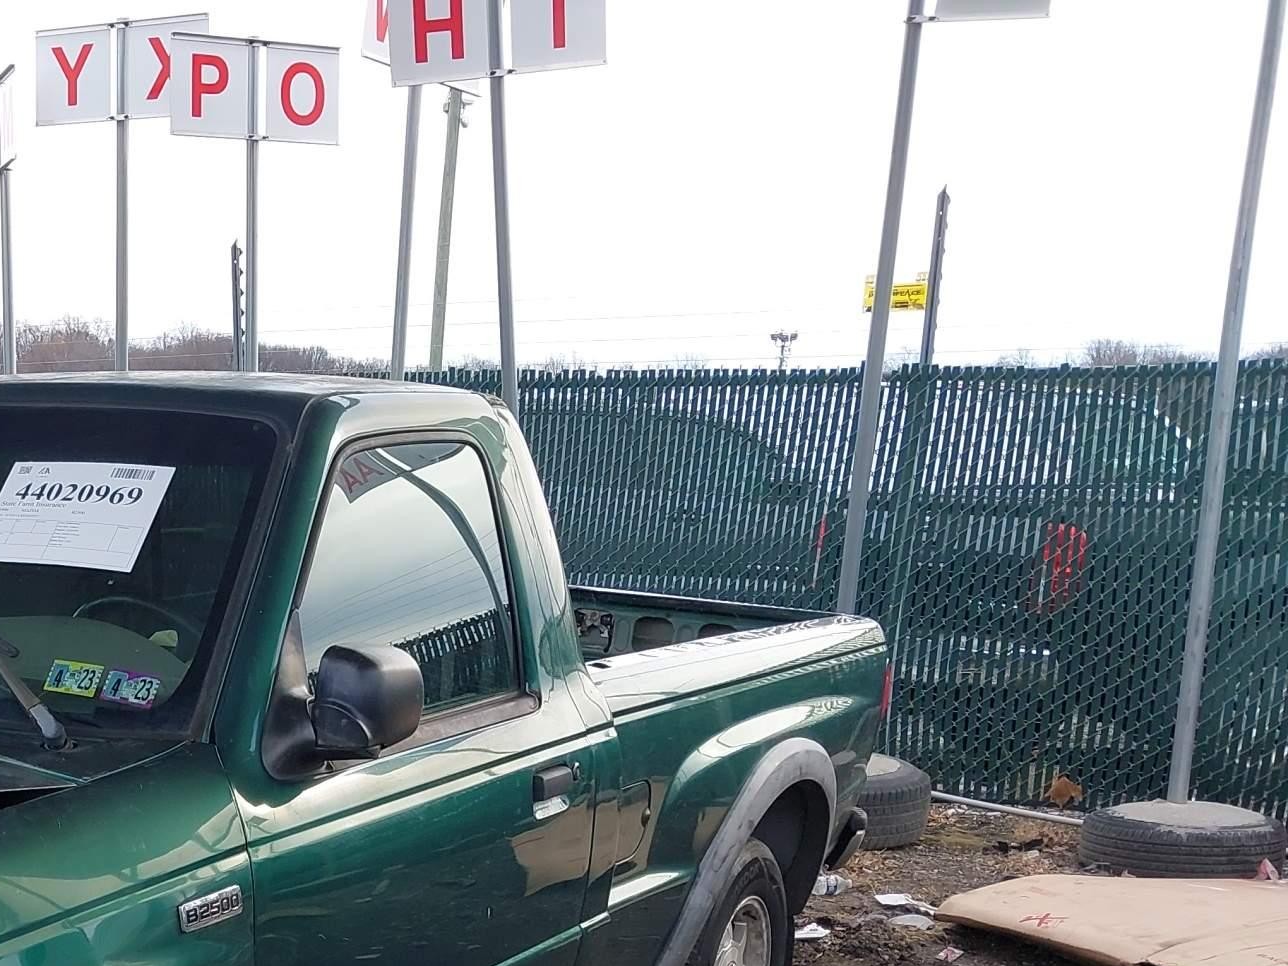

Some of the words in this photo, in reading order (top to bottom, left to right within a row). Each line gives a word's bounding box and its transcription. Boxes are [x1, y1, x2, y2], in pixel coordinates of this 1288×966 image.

[413, 0, 464, 63] H
[51, 43, 94, 106] Y
[191, 53, 229, 118] P
[280, 62, 325, 126] O
[15, 482, 144, 506] 44020969
[53, 669, 64, 688] 4
[77, 669, 96, 691] 23
[110, 678, 123, 697] 4
[134, 679, 154, 701] 23
[185, 893, 240, 925] B2500
